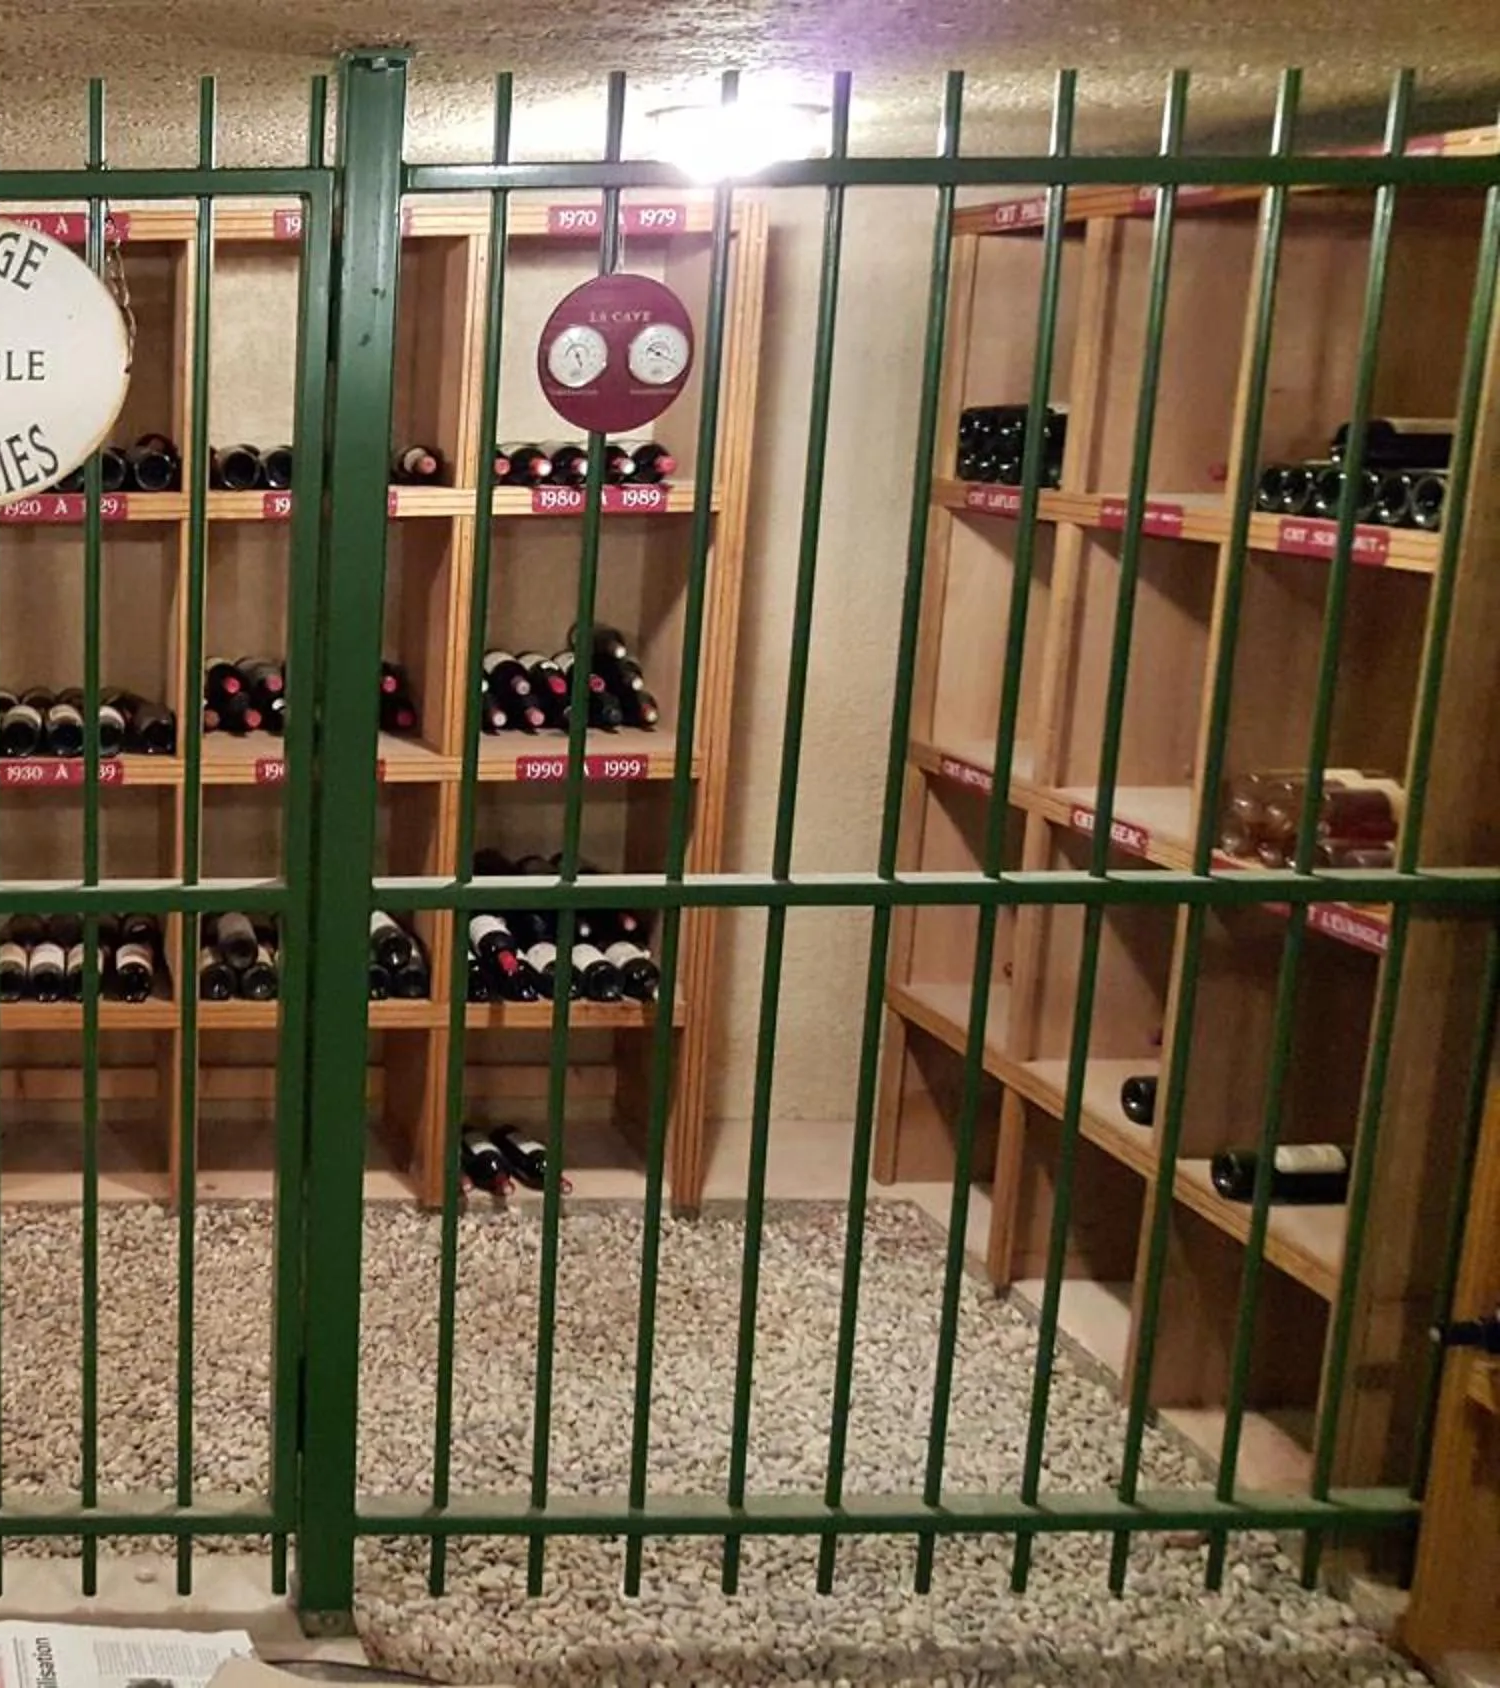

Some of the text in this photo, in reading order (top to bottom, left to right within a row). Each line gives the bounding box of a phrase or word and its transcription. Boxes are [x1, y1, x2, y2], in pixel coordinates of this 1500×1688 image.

[559, 210, 597, 229] 1970
[639, 209, 676, 227] 1979
[4, 500, 42, 516] 1920
[82, 498, 118, 516] 129
[540, 491, 581, 508] 1980
[622, 490, 660, 507] 1989
[6, 765, 43, 782] 1930
[526, 761, 564, 779] 1990
[605, 759, 641, 777] 1999
